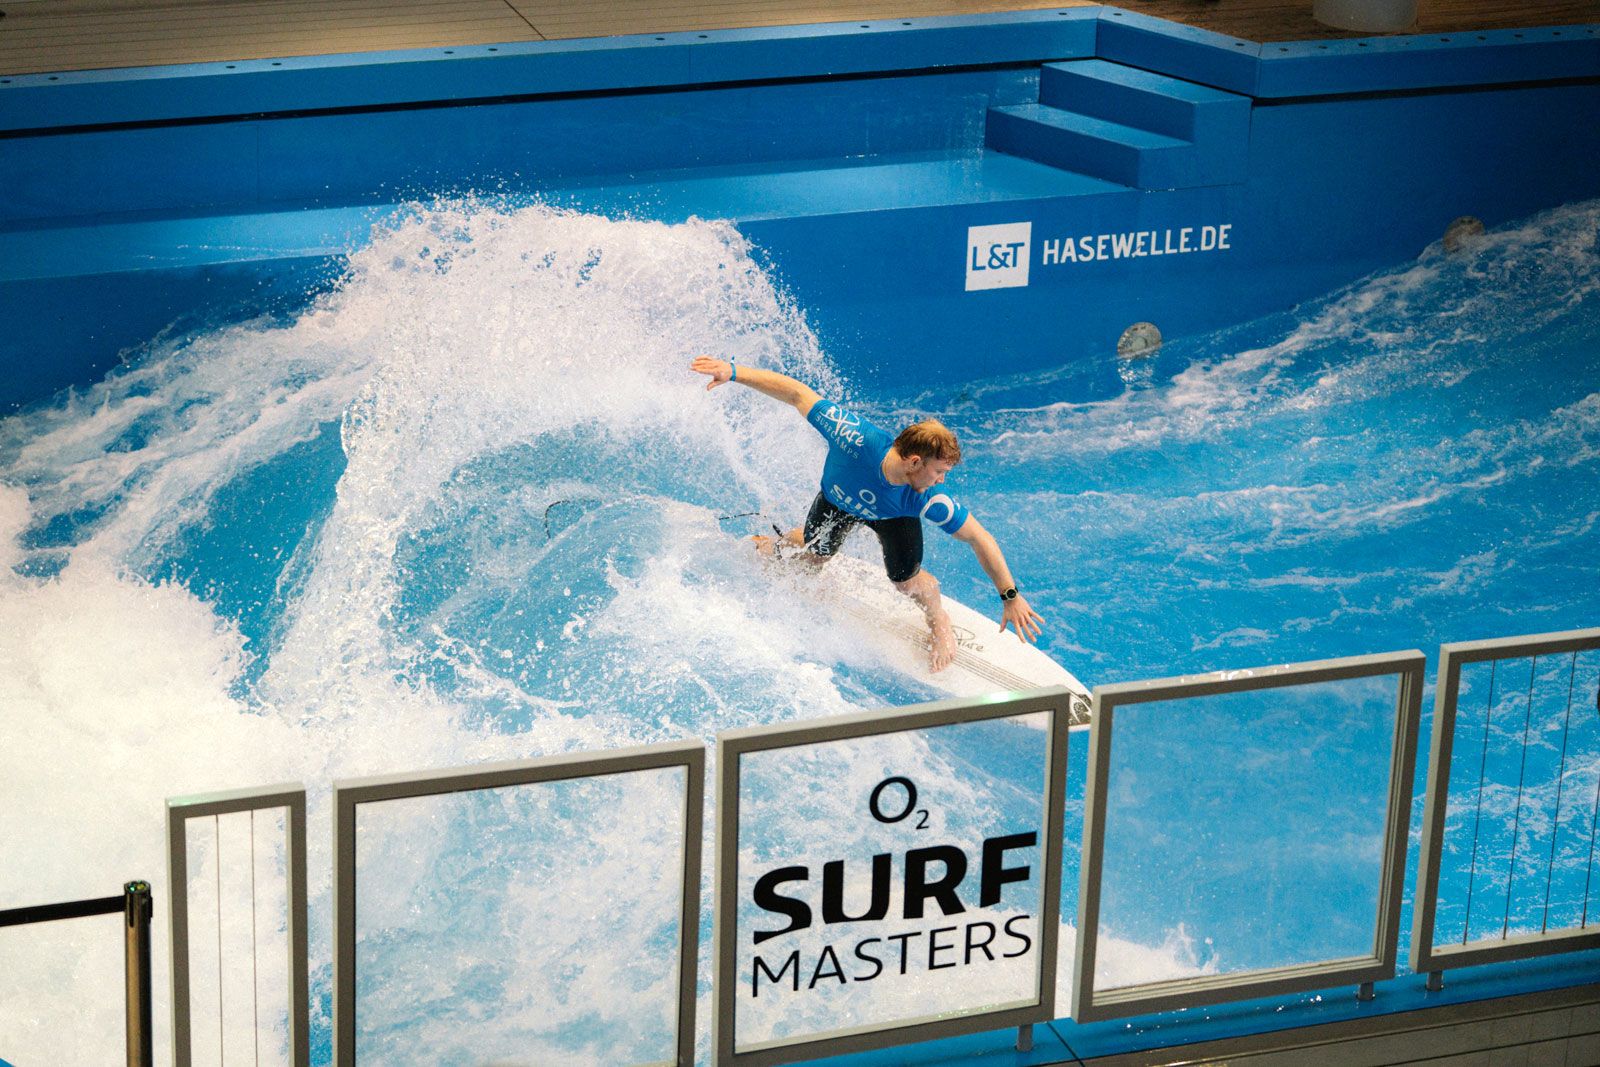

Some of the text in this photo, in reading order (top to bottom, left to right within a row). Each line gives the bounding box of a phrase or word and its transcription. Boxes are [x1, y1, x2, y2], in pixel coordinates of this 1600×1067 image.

[972, 224, 1232, 271] L&T HASEWELLE.DE
[869, 776, 930, 830] O2
[753, 831, 1037, 945] SURF
[752, 915, 1031, 998] MASTERS
